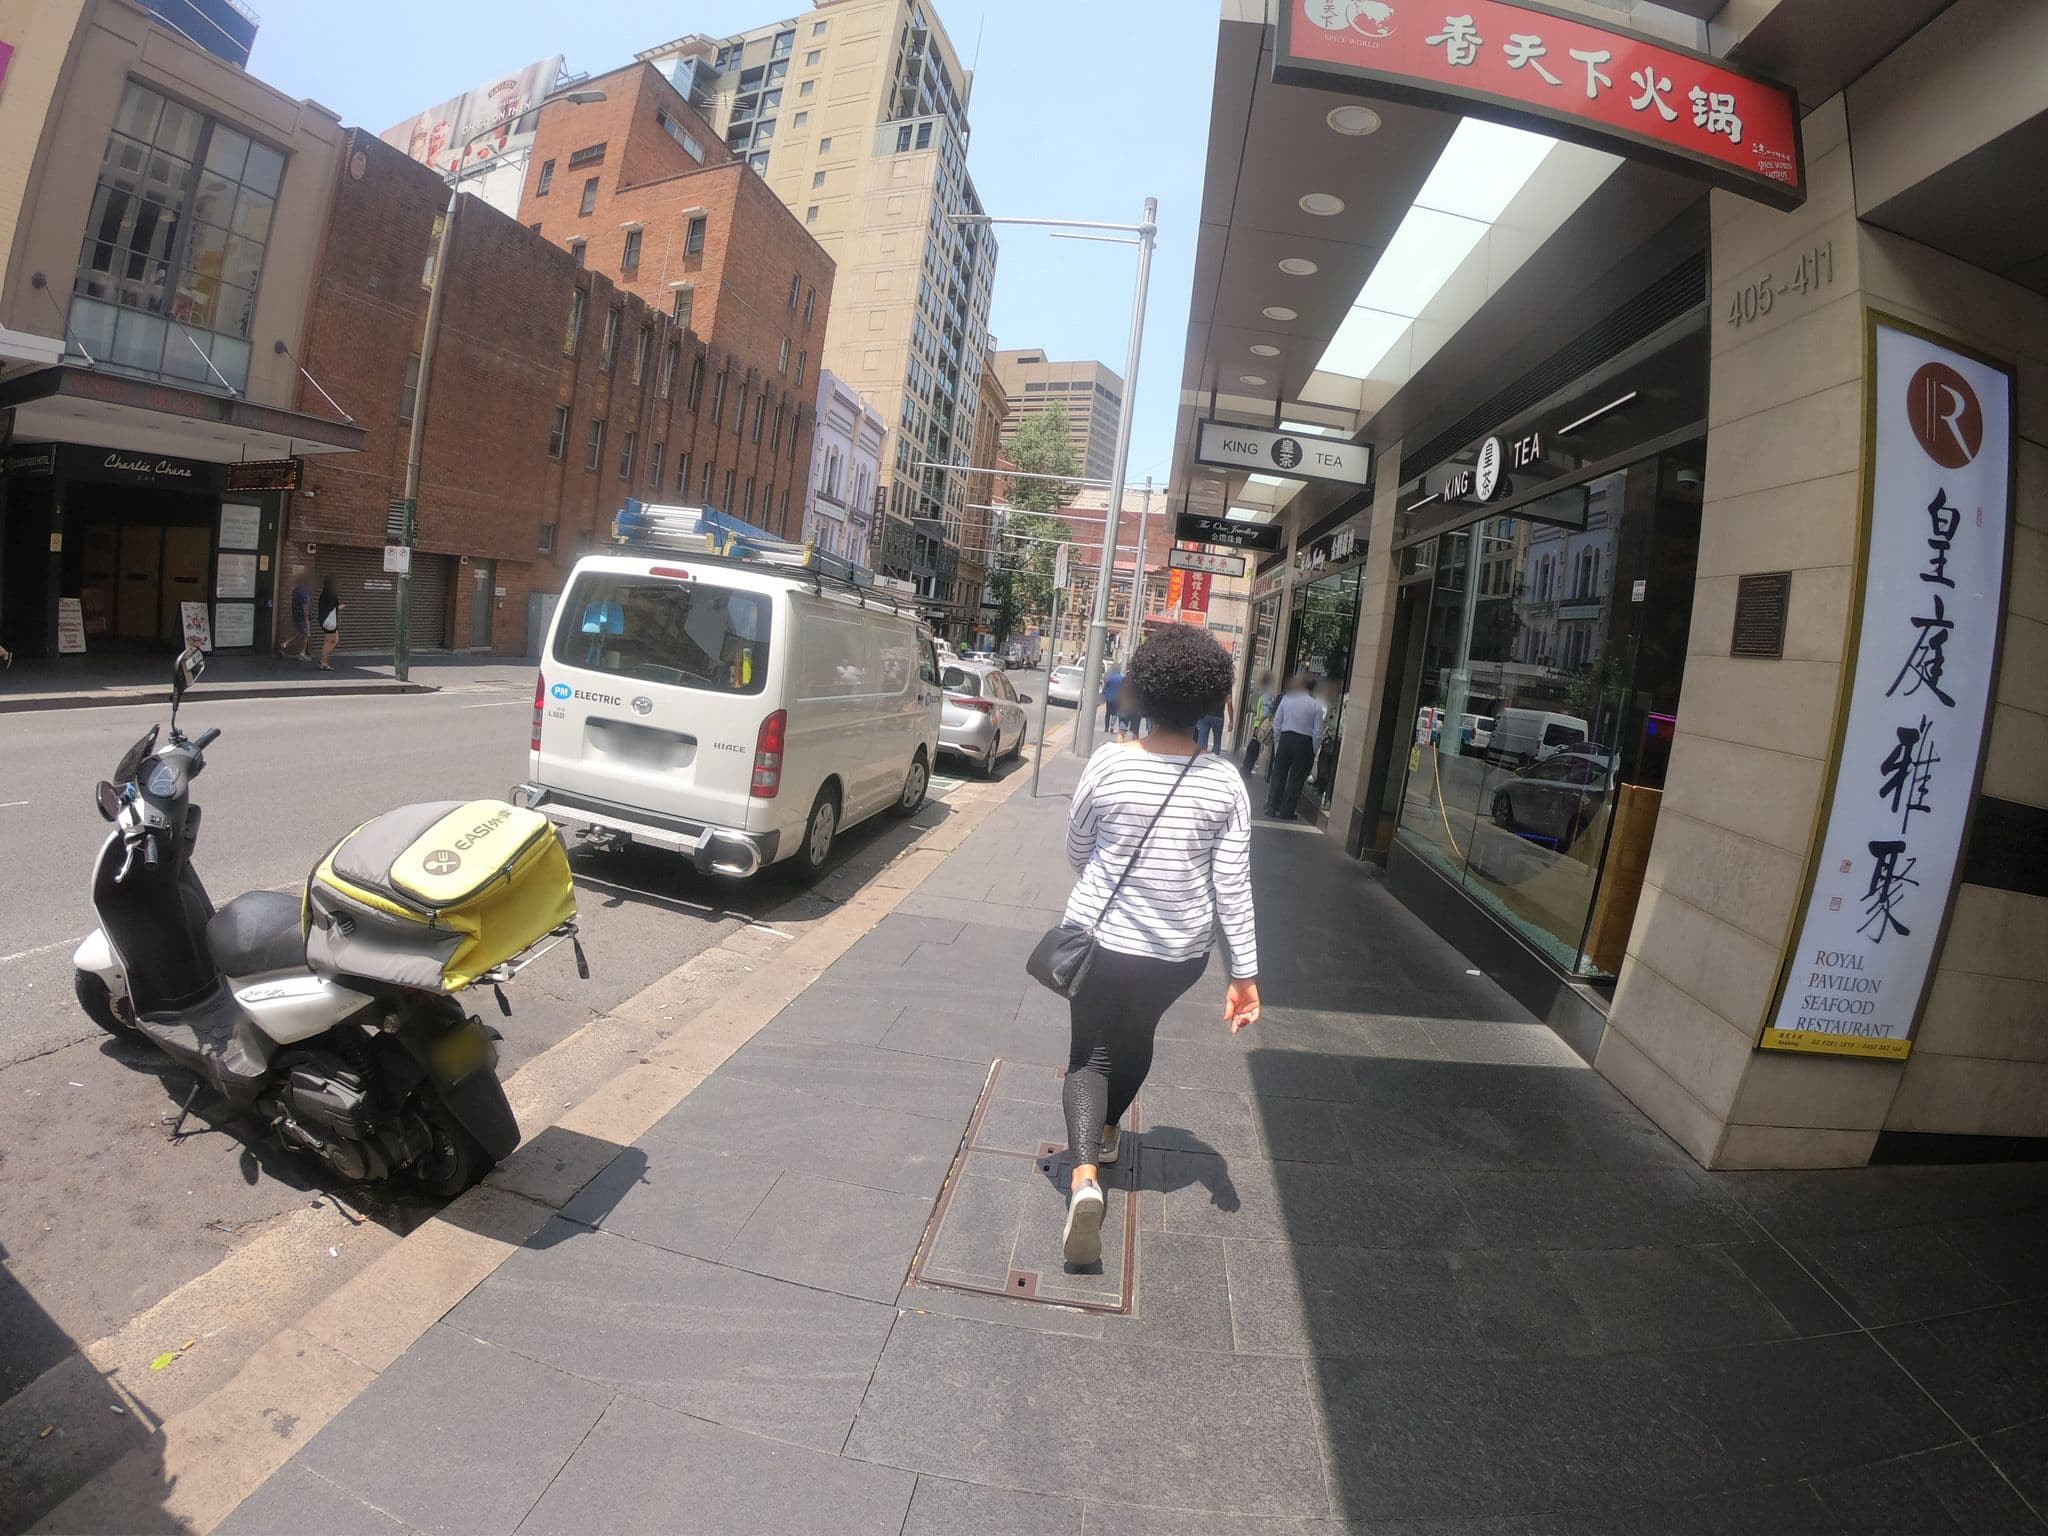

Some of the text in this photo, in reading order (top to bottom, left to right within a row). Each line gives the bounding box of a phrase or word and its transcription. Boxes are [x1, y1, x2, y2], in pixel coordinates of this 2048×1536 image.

[1322, 0, 1339, 28] 天下
[1324, 33, 1380, 49] SPICE WORLD
[1425, 14, 1744, 144] 香天下火锅
[492, 111, 506, 122] ON
[1727, 241, 1833, 328] 405-411
[104, 453, 151, 472] Charlie
[1222, 439, 1344, 468] KING 皇茶 TEA
[1443, 432, 1541, 502] KING 皇茶 TEA
[554, 686, 622, 706] PM ELECTRIC
[1856, 487, 1961, 944] 皇庭雅聚
[713, 741, 747, 754] HIACE
[1814, 950, 1864, 971] ROYAL
[1808, 973, 1882, 994] PAVILION
[1801, 995, 1875, 1016] SEAFOOD
[1796, 1017, 1895, 1038] RESTAURANT
